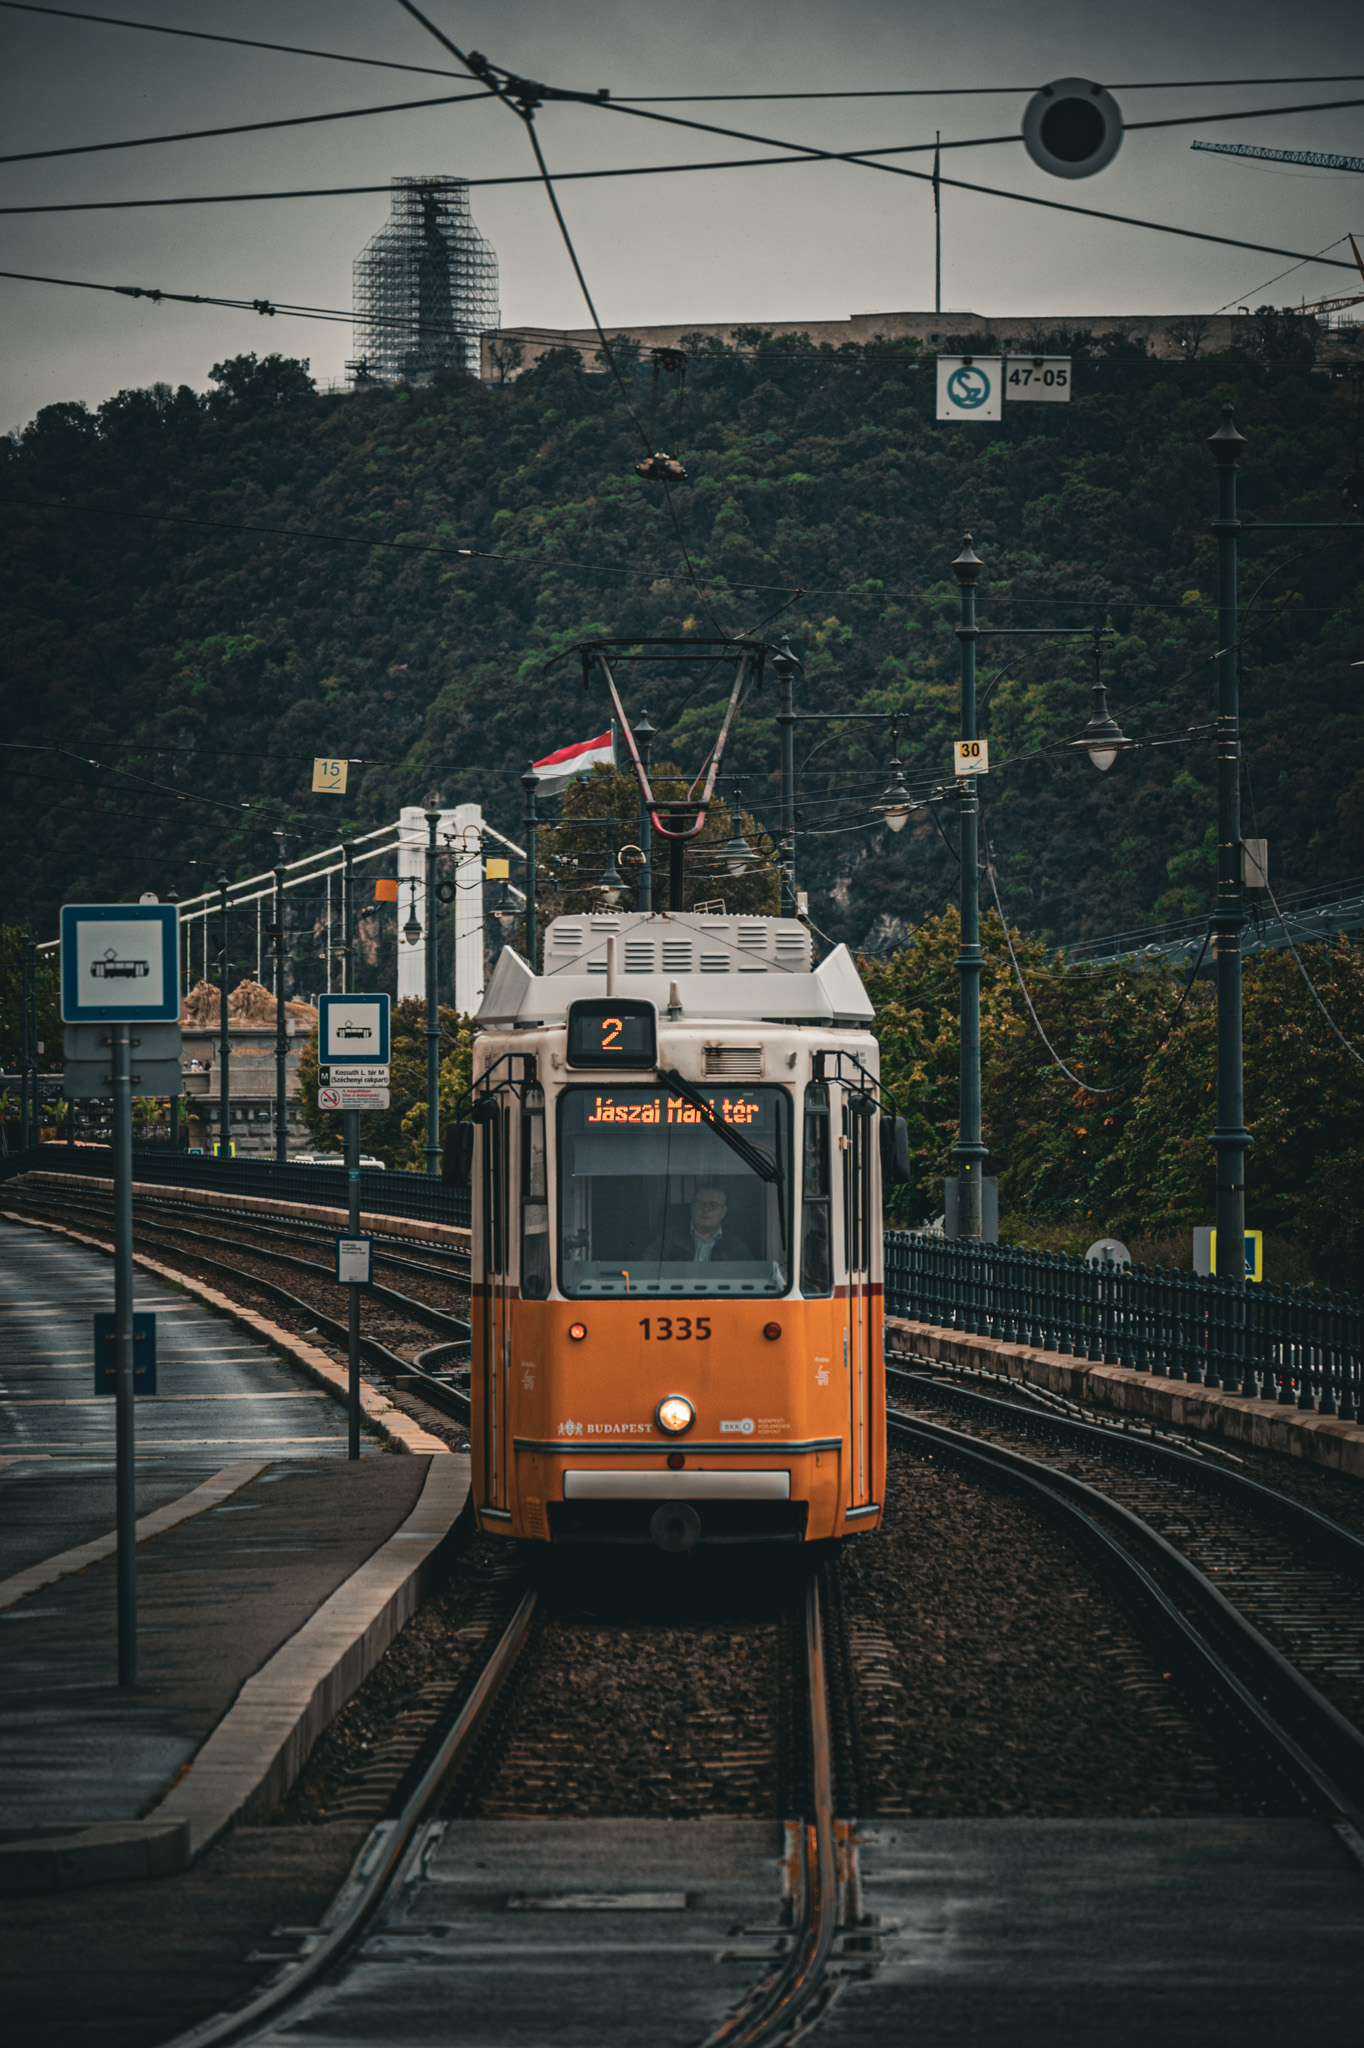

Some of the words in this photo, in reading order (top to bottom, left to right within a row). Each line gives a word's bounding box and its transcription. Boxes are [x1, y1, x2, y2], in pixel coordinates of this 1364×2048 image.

[1008, 369, 1068, 386] 47-05
[961, 743, 980, 757] 30
[321, 761, 340, 776] 15
[601, 1018, 623, 1050] 2
[331, 1076, 363, 1084] (Széchenyi
[588, 1097, 660, 1123] Jászai
[722, 1098, 759, 1123] tér
[639, 1317, 712, 1341] 1335
[587, 1423, 652, 1433] BUDAPEST
